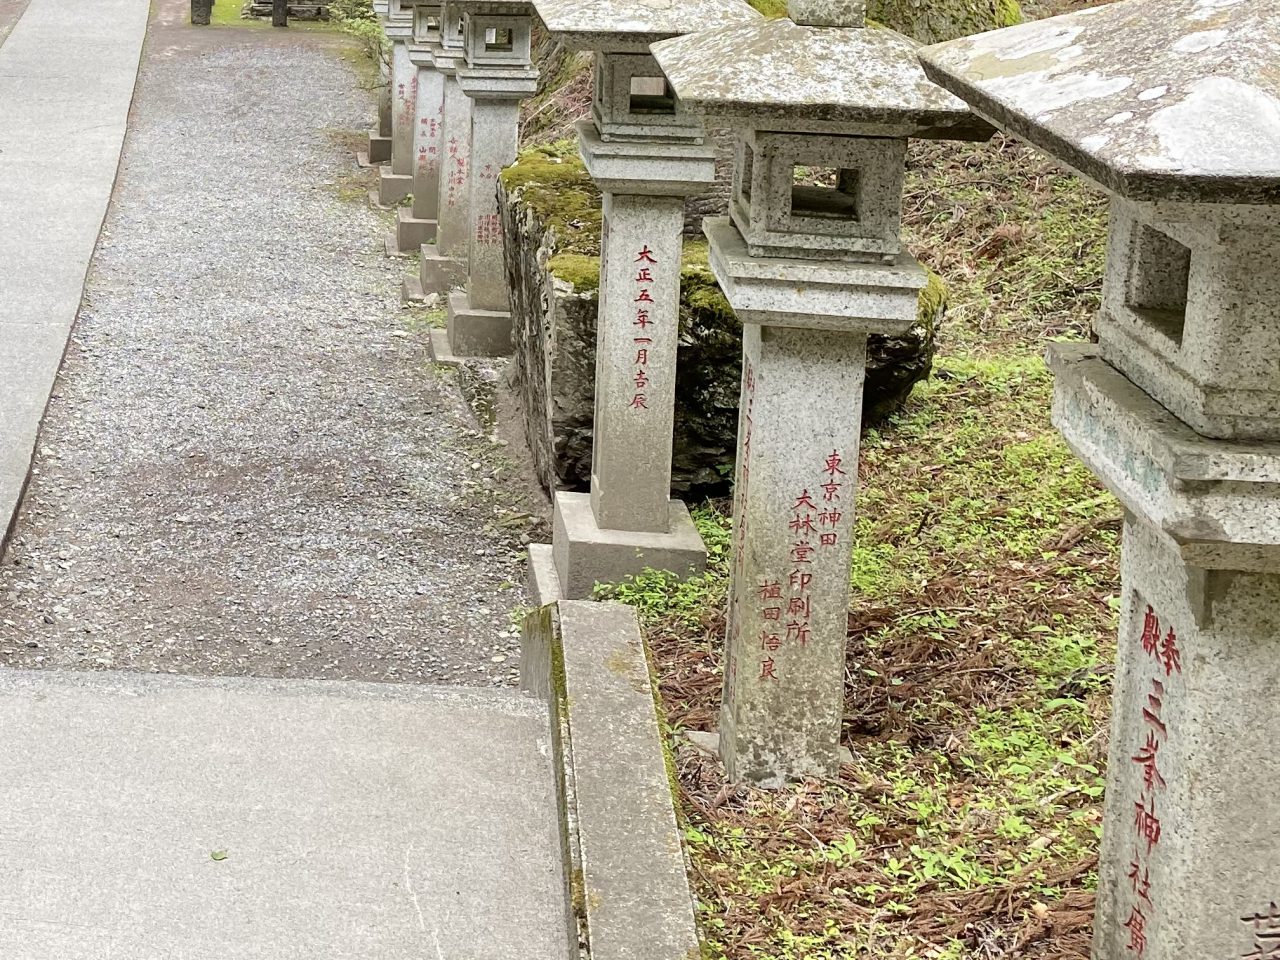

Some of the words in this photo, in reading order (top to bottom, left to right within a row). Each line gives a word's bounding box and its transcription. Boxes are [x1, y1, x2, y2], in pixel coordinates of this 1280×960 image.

[628, 244, 658, 409] 大正五年一月吉辰
[818, 448, 847, 546] 東京神田
[758, 579, 785, 681] 植田悟良
[786, 488, 818, 646] 大林堂印刷所
